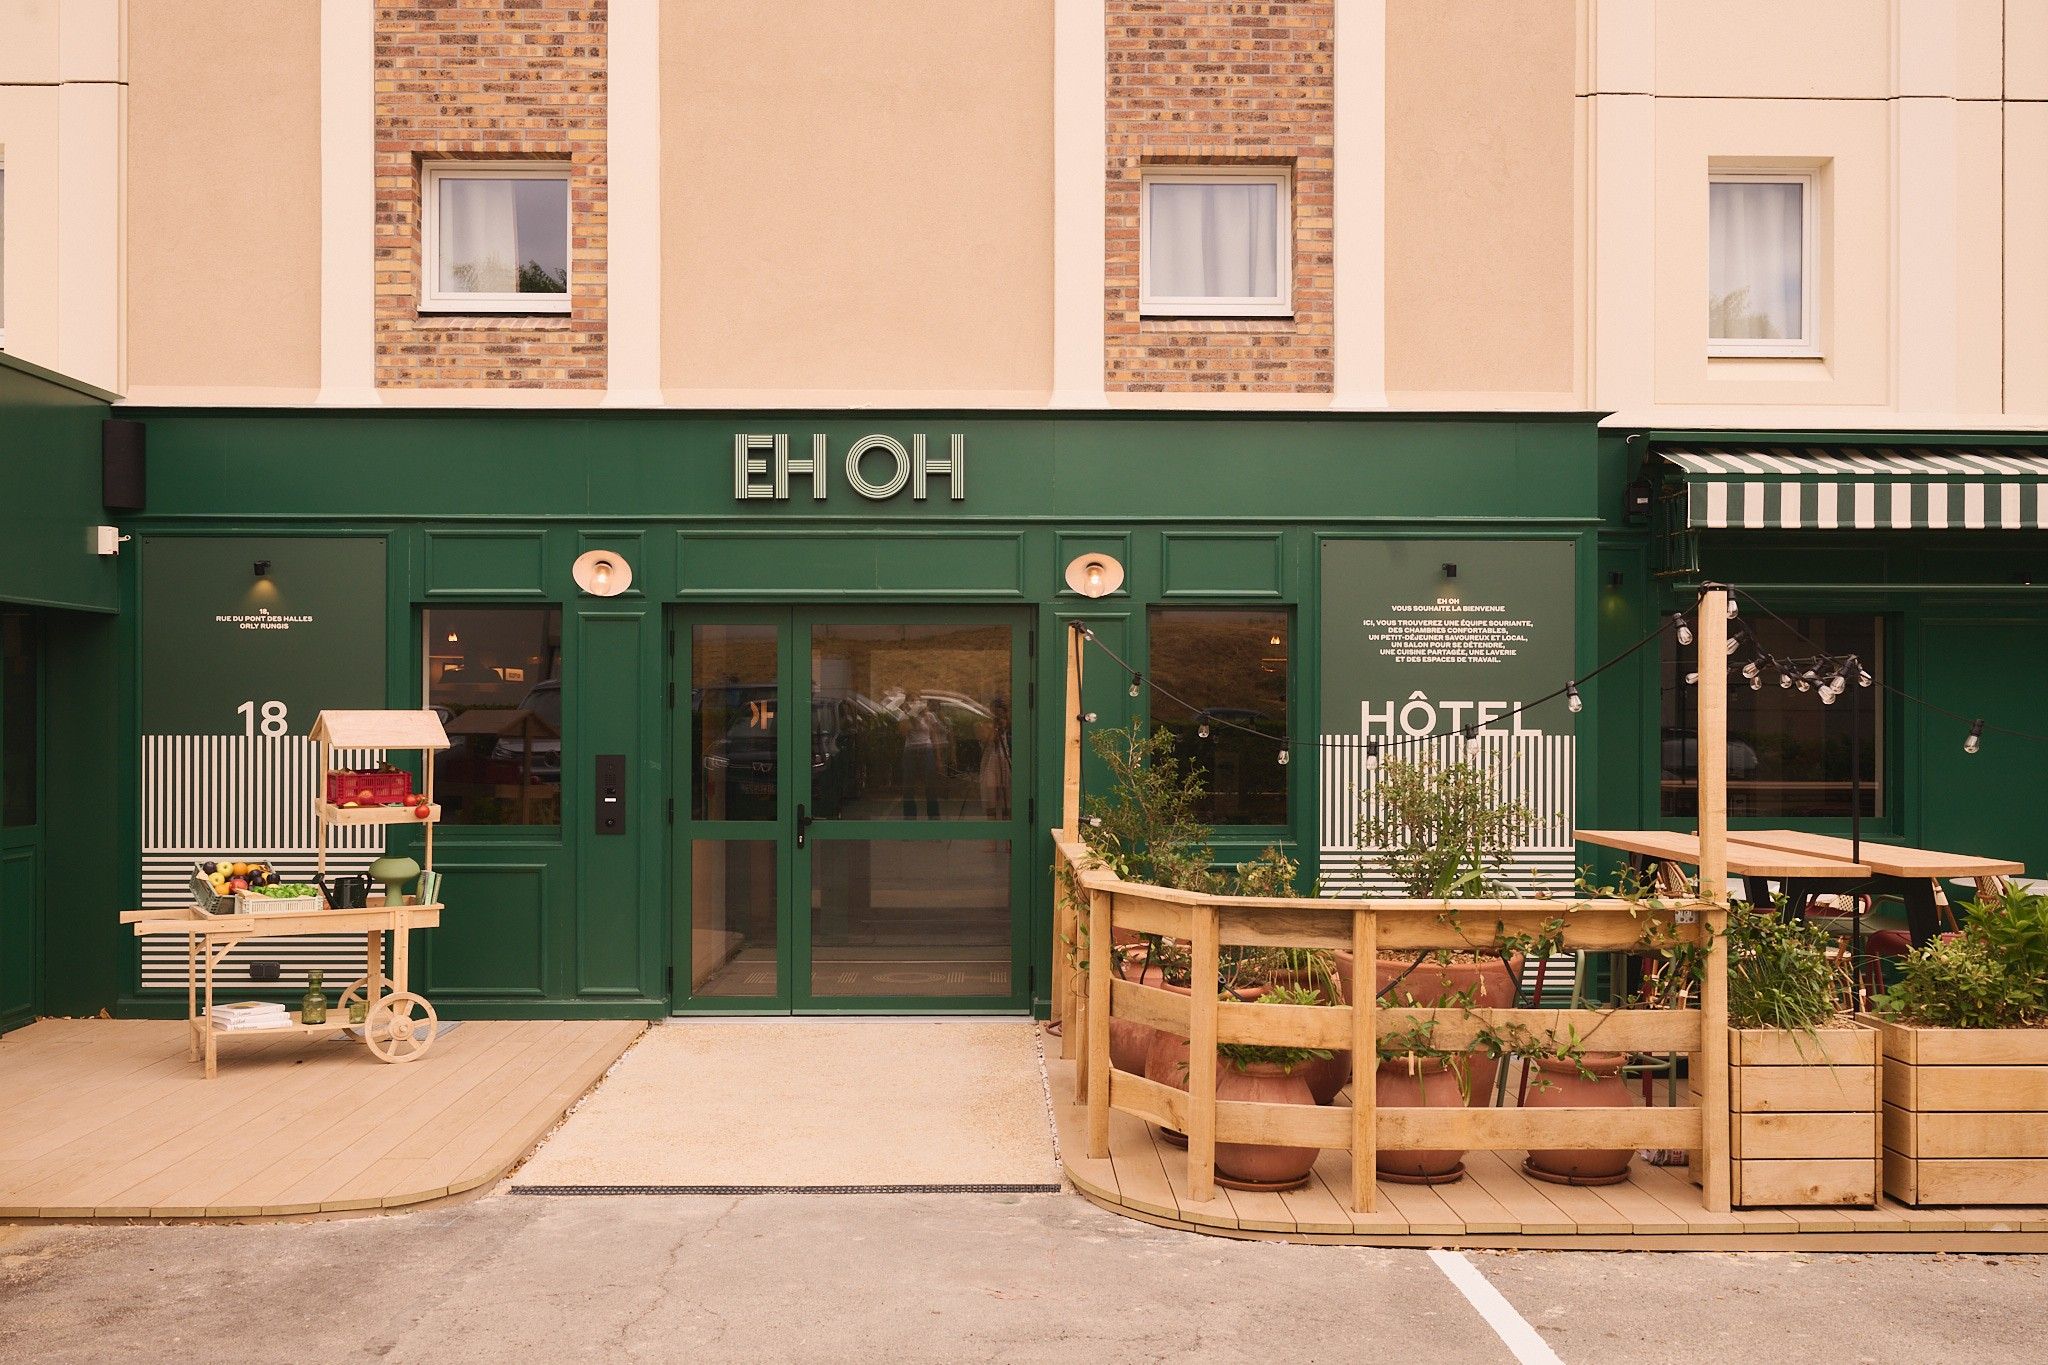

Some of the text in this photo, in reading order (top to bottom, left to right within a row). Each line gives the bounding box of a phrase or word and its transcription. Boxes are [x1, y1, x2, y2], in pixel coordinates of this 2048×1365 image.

[735, 434, 964, 499] EH OH
[1460, 619, 1488, 627] ÉQUIPE
[1427, 648, 1468, 656] PARTAGÉE,
[1463, 641, 1506, 649] DÉTENDRE,
[237, 700, 288, 737] 18
[1361, 690, 1542, 737] HÔTEL
